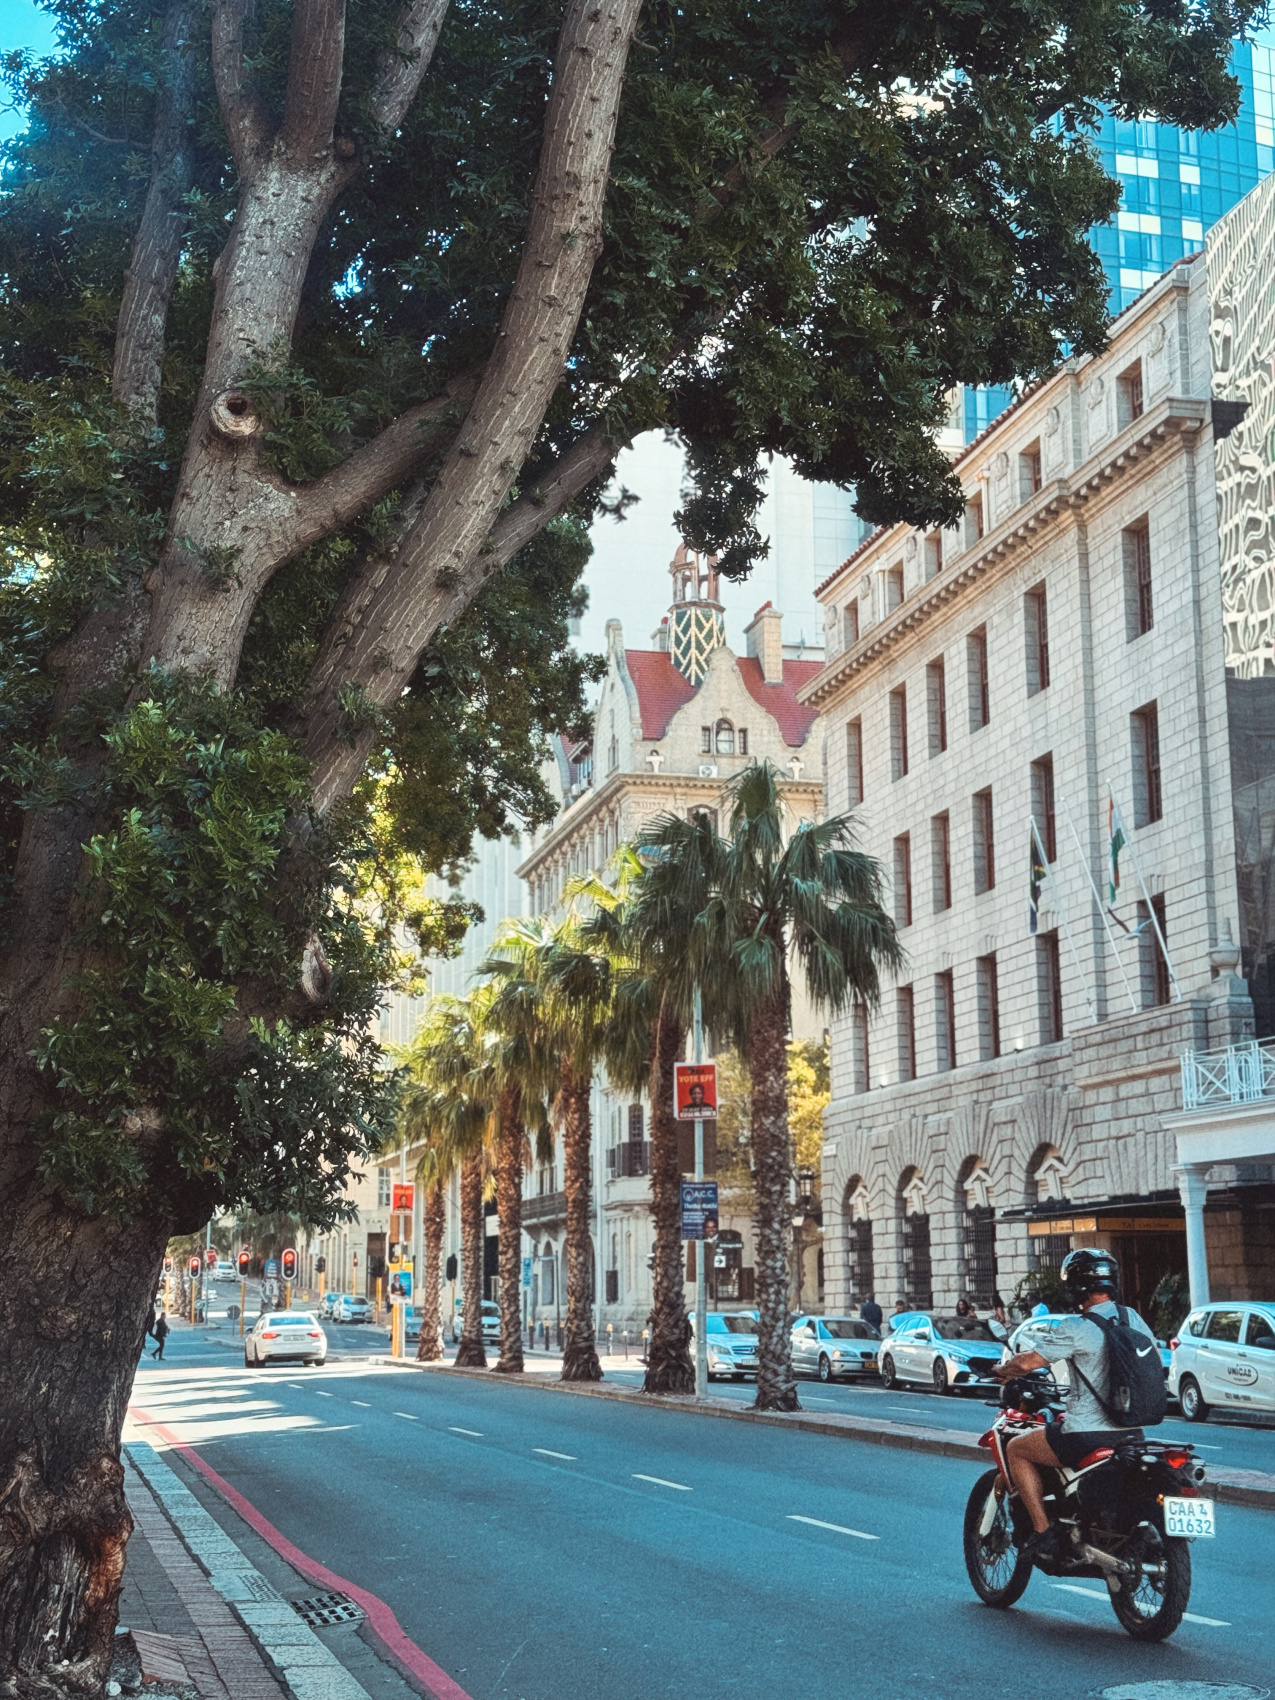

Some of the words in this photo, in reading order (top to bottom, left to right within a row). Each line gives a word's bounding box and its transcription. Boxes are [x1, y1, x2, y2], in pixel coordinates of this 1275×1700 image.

[679, 1075, 698, 1083] VOTE
[700, 1074, 714, 1082] EFF
[1169, 1501, 1196, 1516] CAA
[1168, 1517, 1213, 1534] 01632
